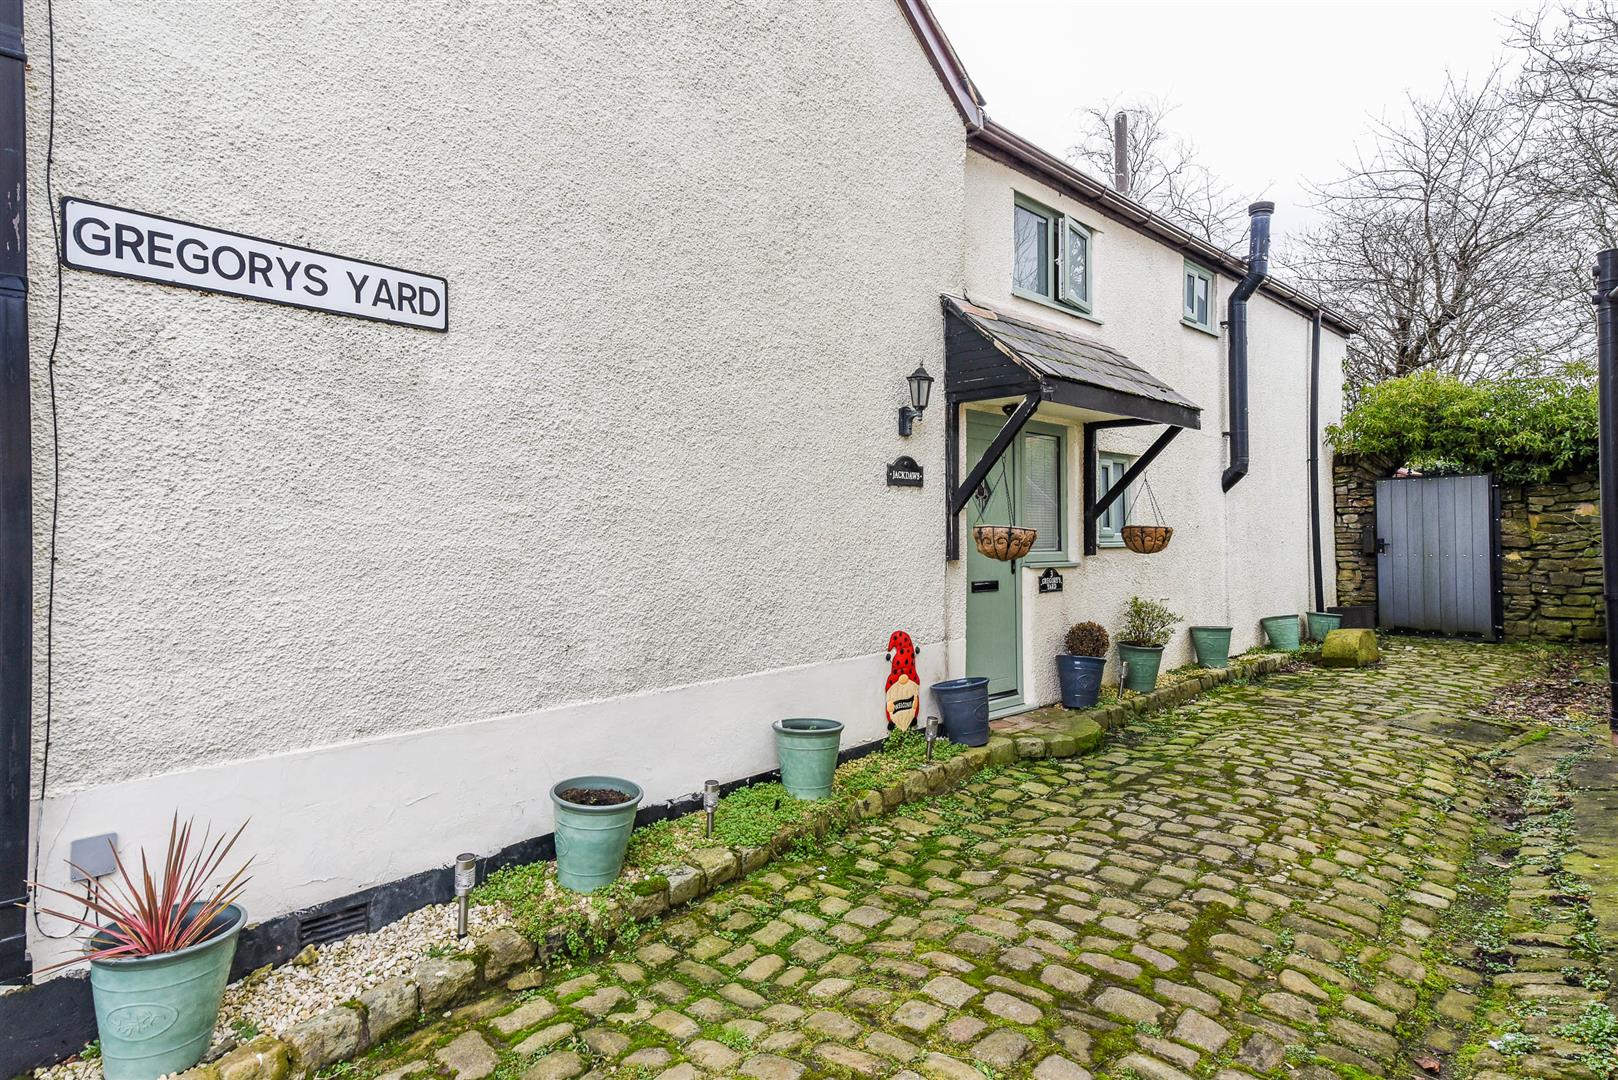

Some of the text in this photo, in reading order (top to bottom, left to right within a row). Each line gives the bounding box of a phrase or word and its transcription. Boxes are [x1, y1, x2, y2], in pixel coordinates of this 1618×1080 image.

[73, 217, 440, 317] GREGORYS YARD
[892, 470, 920, 480] JACKDAWS
